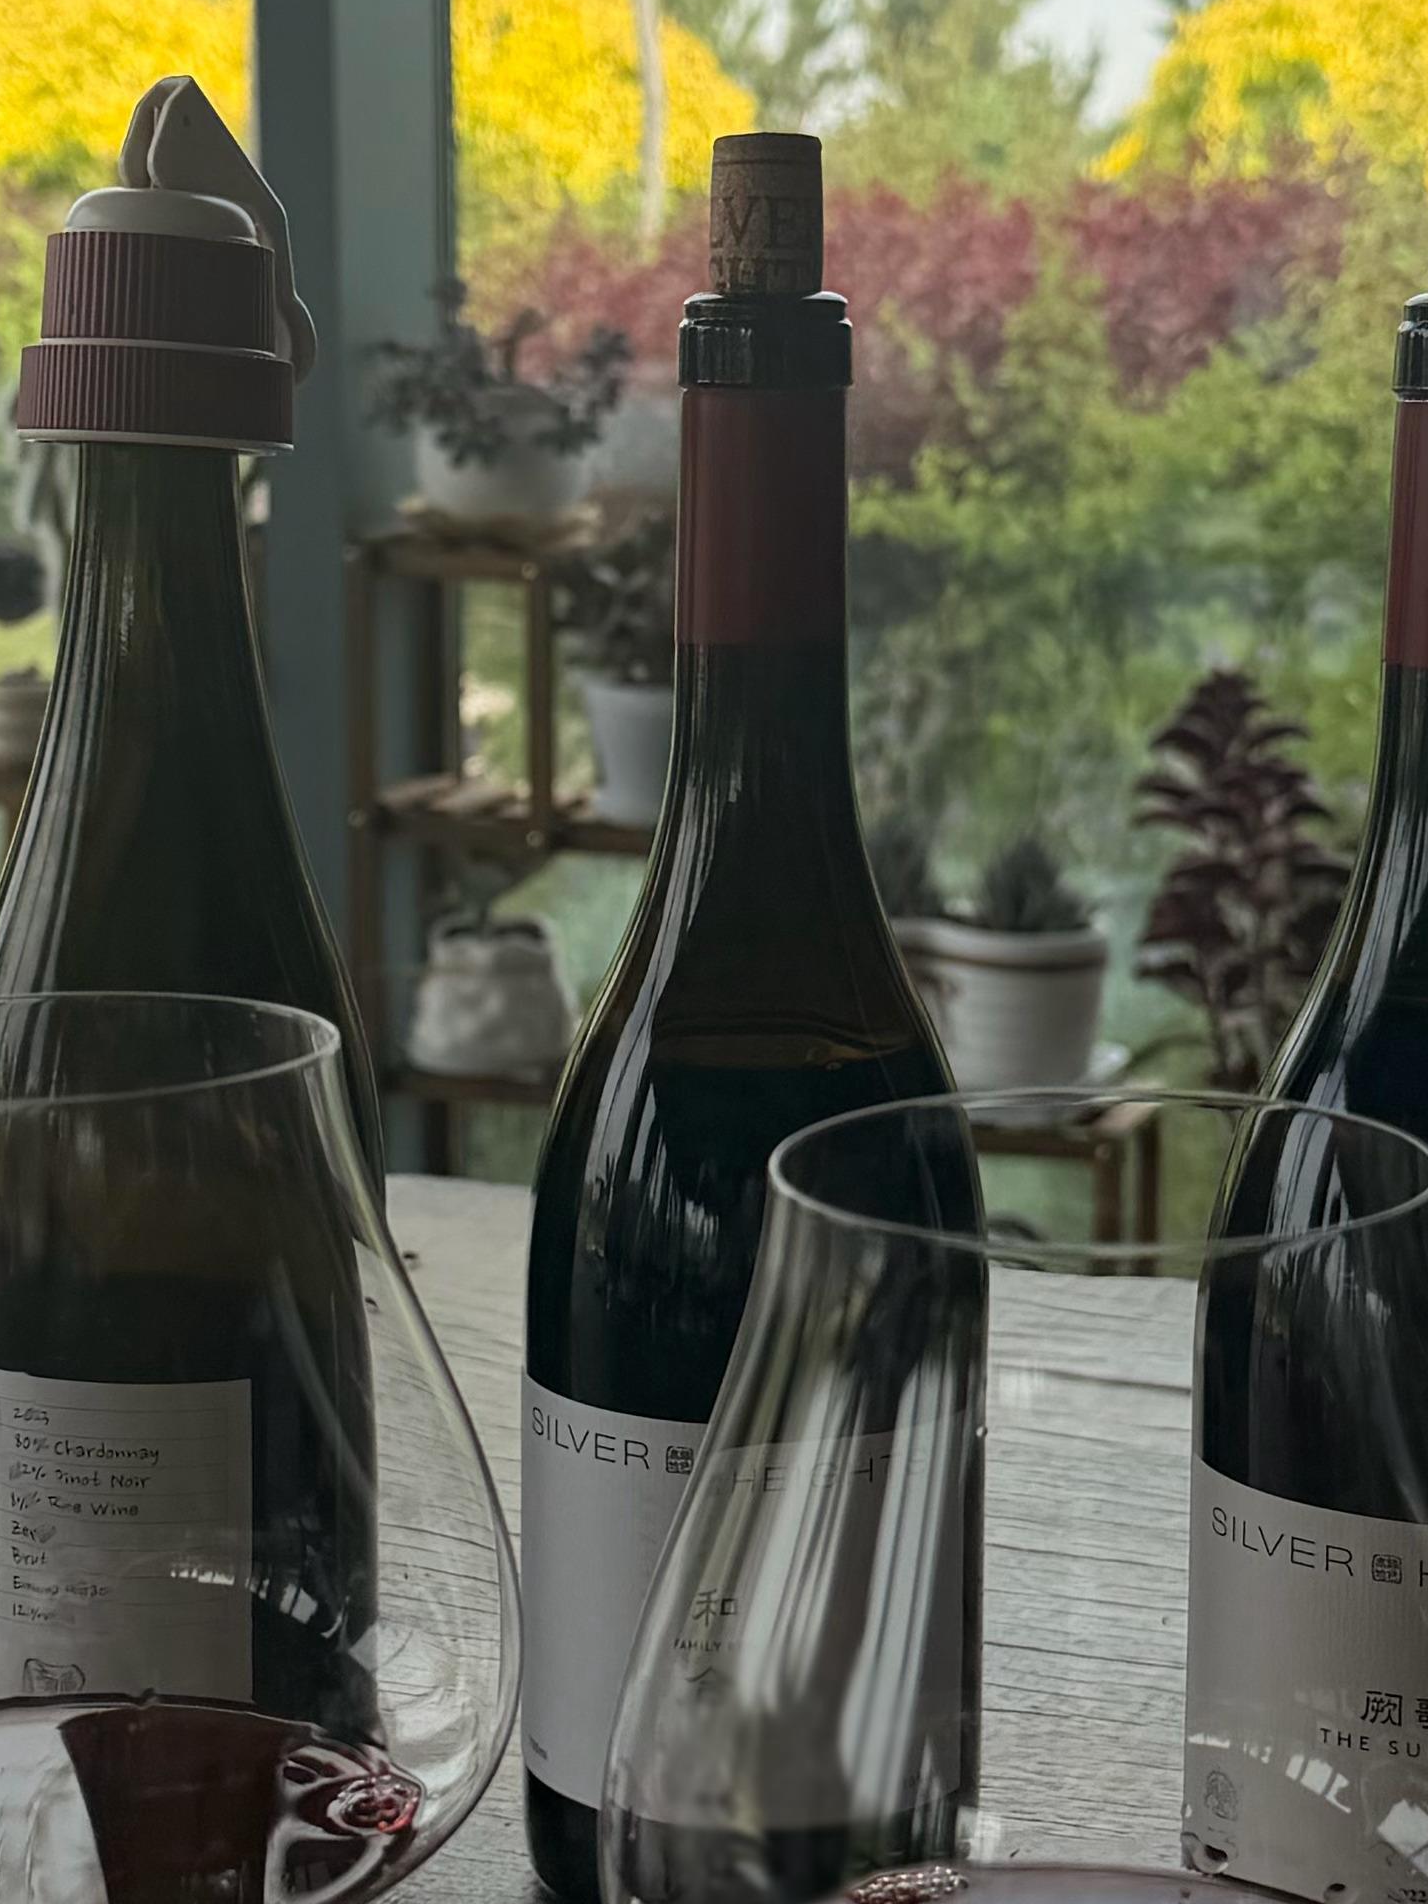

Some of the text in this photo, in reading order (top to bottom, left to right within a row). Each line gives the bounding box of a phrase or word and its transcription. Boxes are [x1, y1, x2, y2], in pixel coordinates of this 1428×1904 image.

[531, 1406, 650, 1470] SILVER
[54, 1440, 160, 1466] Chardonnay
[110, 1474, 152, 1489] Noir
[90, 1502, 140, 1516] Wine
[1211, 1506, 1354, 1578] SILVER
[1319, 1727, 1371, 1752] THE
